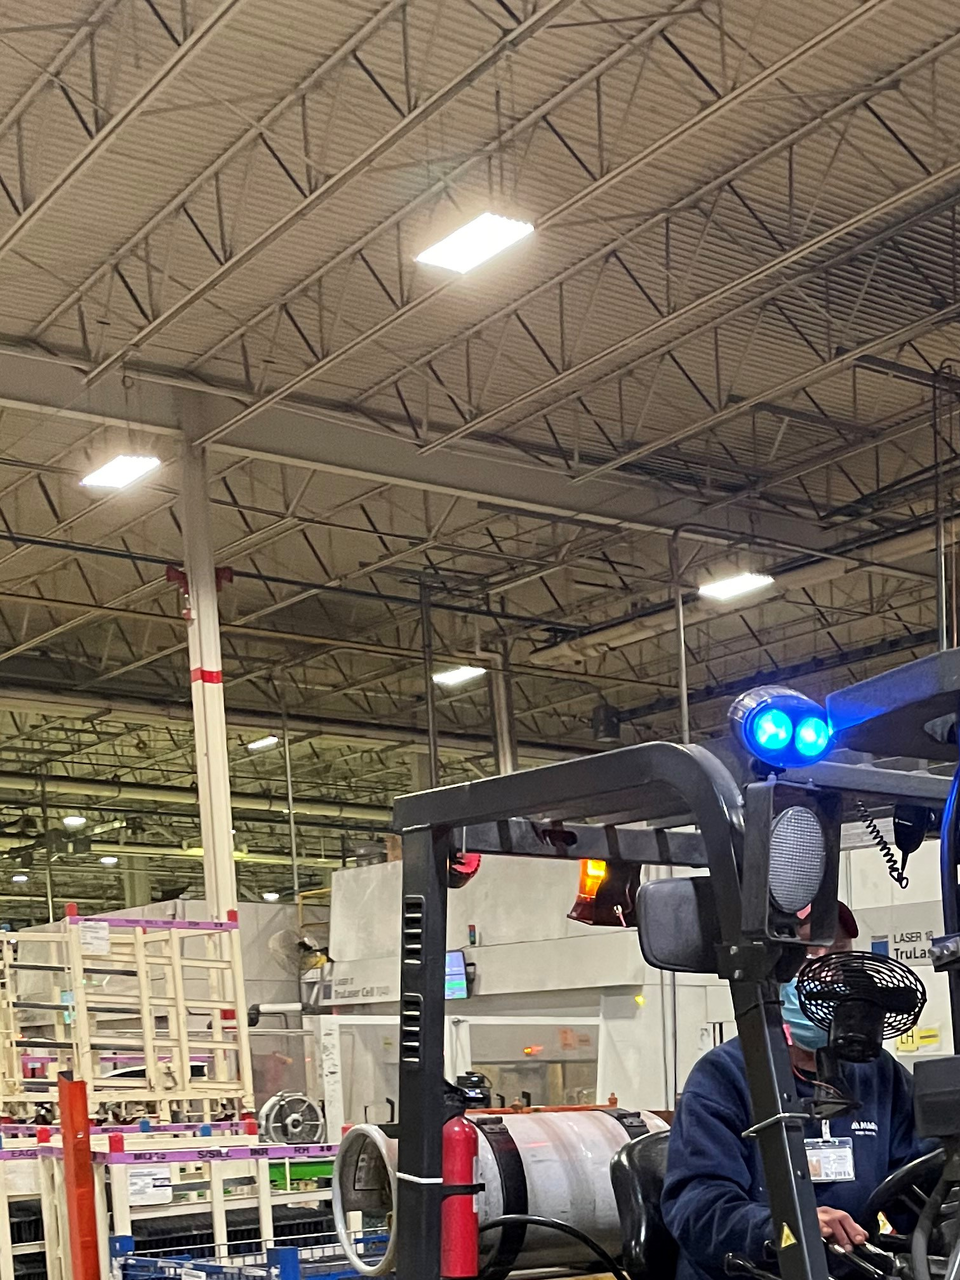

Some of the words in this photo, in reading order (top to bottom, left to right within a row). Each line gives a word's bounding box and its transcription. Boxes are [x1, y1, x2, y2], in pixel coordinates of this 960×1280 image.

[894, 932, 921, 944] LASER
[894, 947, 931, 960] TruLa
[362, 986, 374, 998] Cell
[294, 1146, 309, 1154] RH
